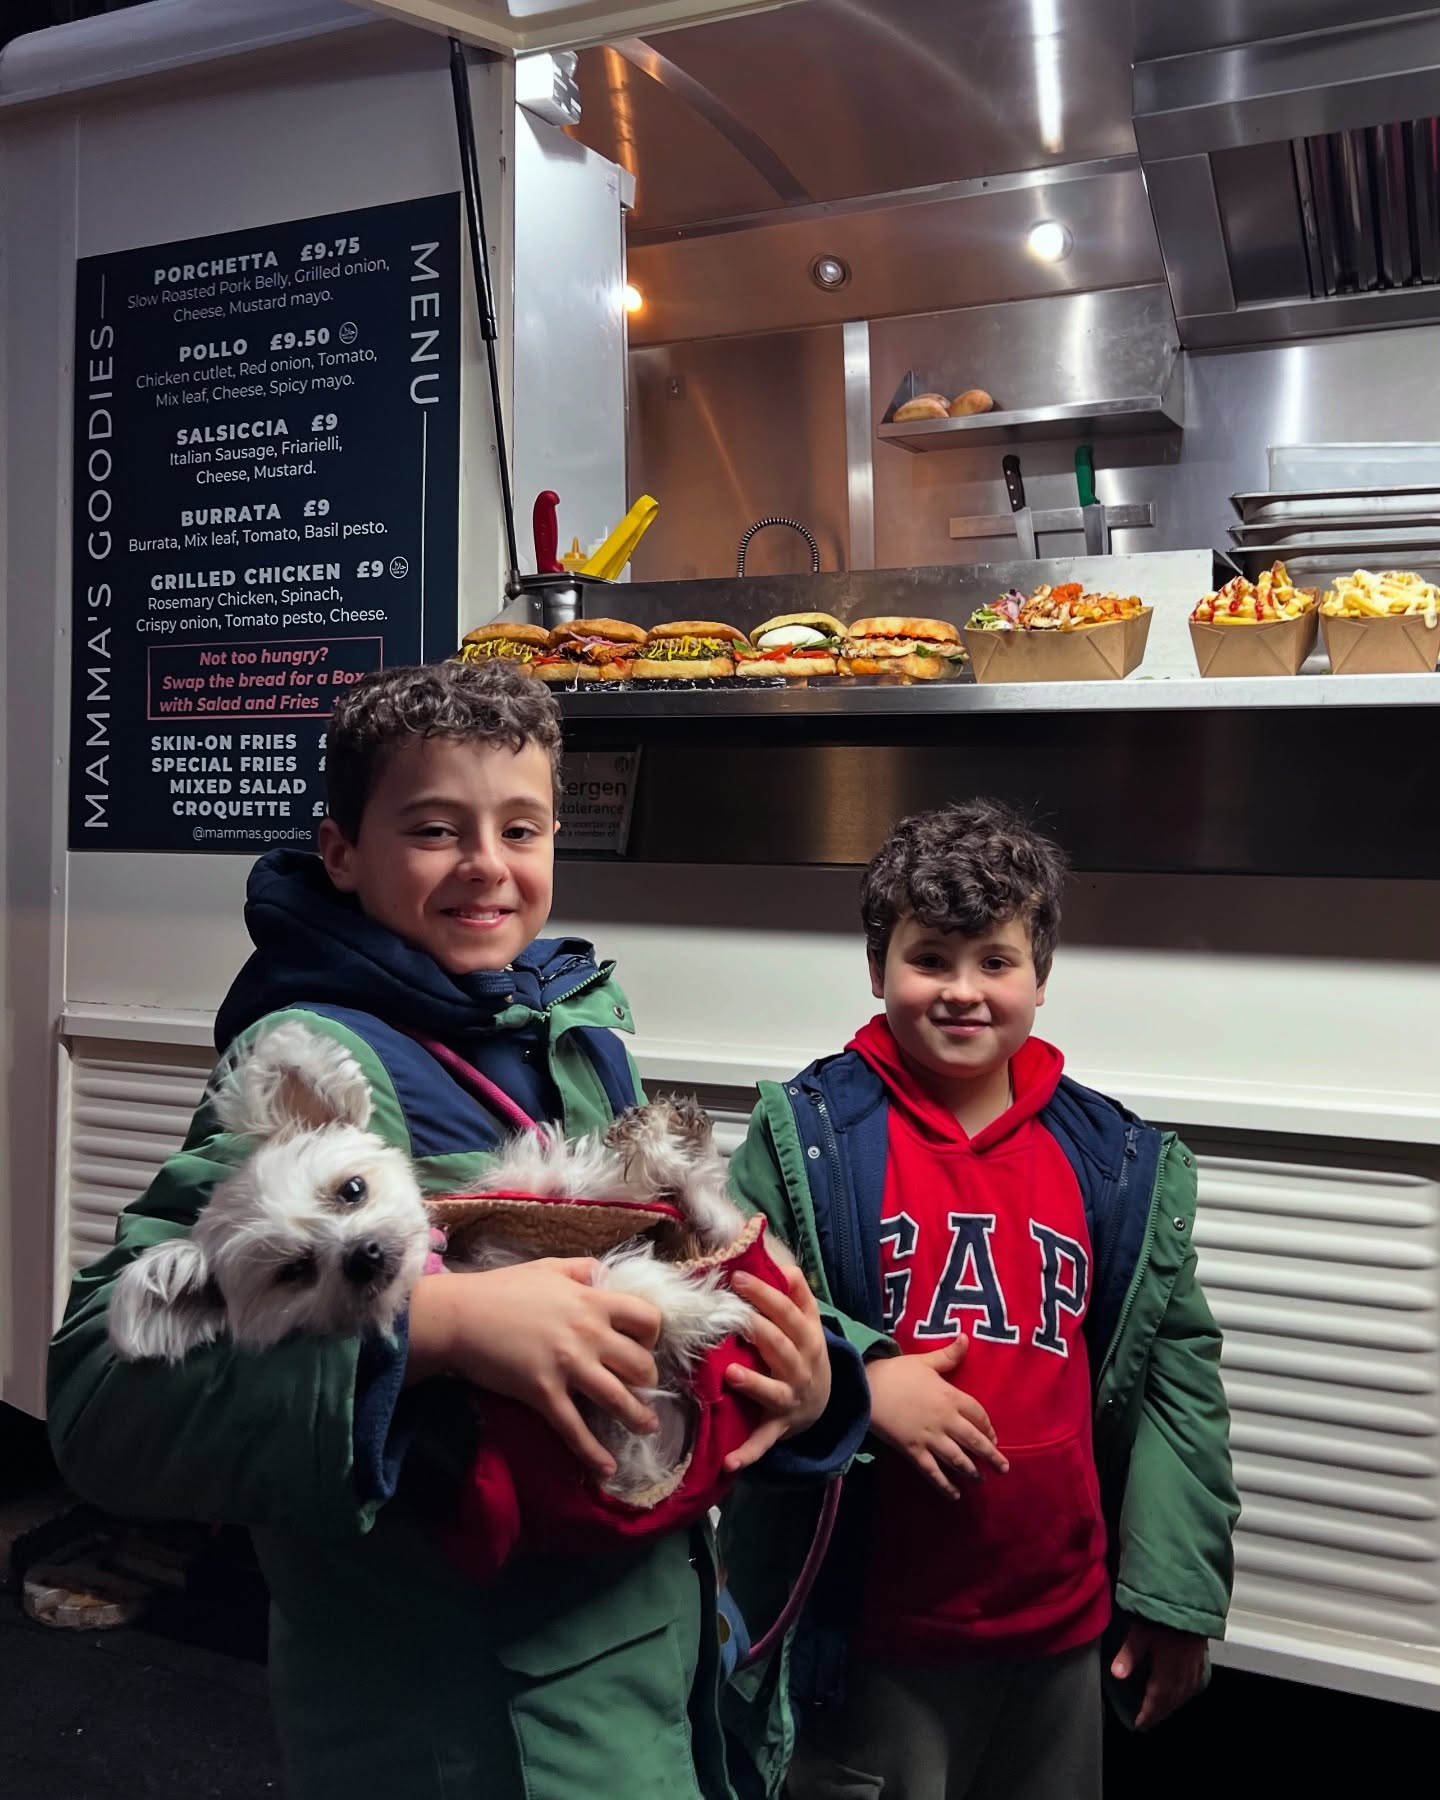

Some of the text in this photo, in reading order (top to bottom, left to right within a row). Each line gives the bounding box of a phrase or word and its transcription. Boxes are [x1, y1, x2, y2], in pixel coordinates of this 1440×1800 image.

[155, 237, 360, 286] PORCHETTA £9.75
[128, 258, 389, 309] Slow Roasted Pork Belly, Grilled onion,
[174, 290, 333, 322] Cheese, Mustard mayo.
[409, 241, 440, 404] MENU
[180, 328, 330, 362] POLLO £9.50
[136, 349, 377, 388] Chicken cutlet, Red onion, Tomato,
[156, 374, 355, 407] Mix leaf, Cheese, Spicy mayo.
[177, 413, 337, 445] SALSICCIA £9
[170, 435, 342, 466] Italian Sausage, Friarielli,
[196, 460, 316, 484] Cheese, Mustard.
[181, 499, 330, 526] BURRATA £9
[129, 521, 388, 552] Burrata, Mix leaf, Tomato, Basil pesto.
[85, 325, 113, 828] MAMMA'S GOODIES
[151, 560, 384, 591] GRILLED CHICKEN £9
[148, 586, 343, 610] Rosemary Chicken, Spinach,
[136, 608, 388, 634] Crispy onion, Tomato pesto, Cheese.
[200, 647, 329, 666] Not too hungry?
[163, 670, 365, 692] Swap the bread for a Box
[160, 697, 193, 712] with
[196, 696, 242, 711] Salad
[245, 695, 277, 710] and
[280, 693, 319, 709] Fries
[151, 735, 232, 751] SKIN-ON
[240, 734, 296, 750] FRIES
[152, 757, 233, 772] SPECIAL
[241, 756, 297, 772] FRIES
[170, 779, 306, 794] MIXED SALAD
[563, 782, 627, 801] ergen
[173, 801, 290, 819] CROQUETTE
[560, 801, 625, 815] tolerance
[193, 826, 312, 842] @mammas.goodies
[880, 1211, 1089, 1358] GAP
